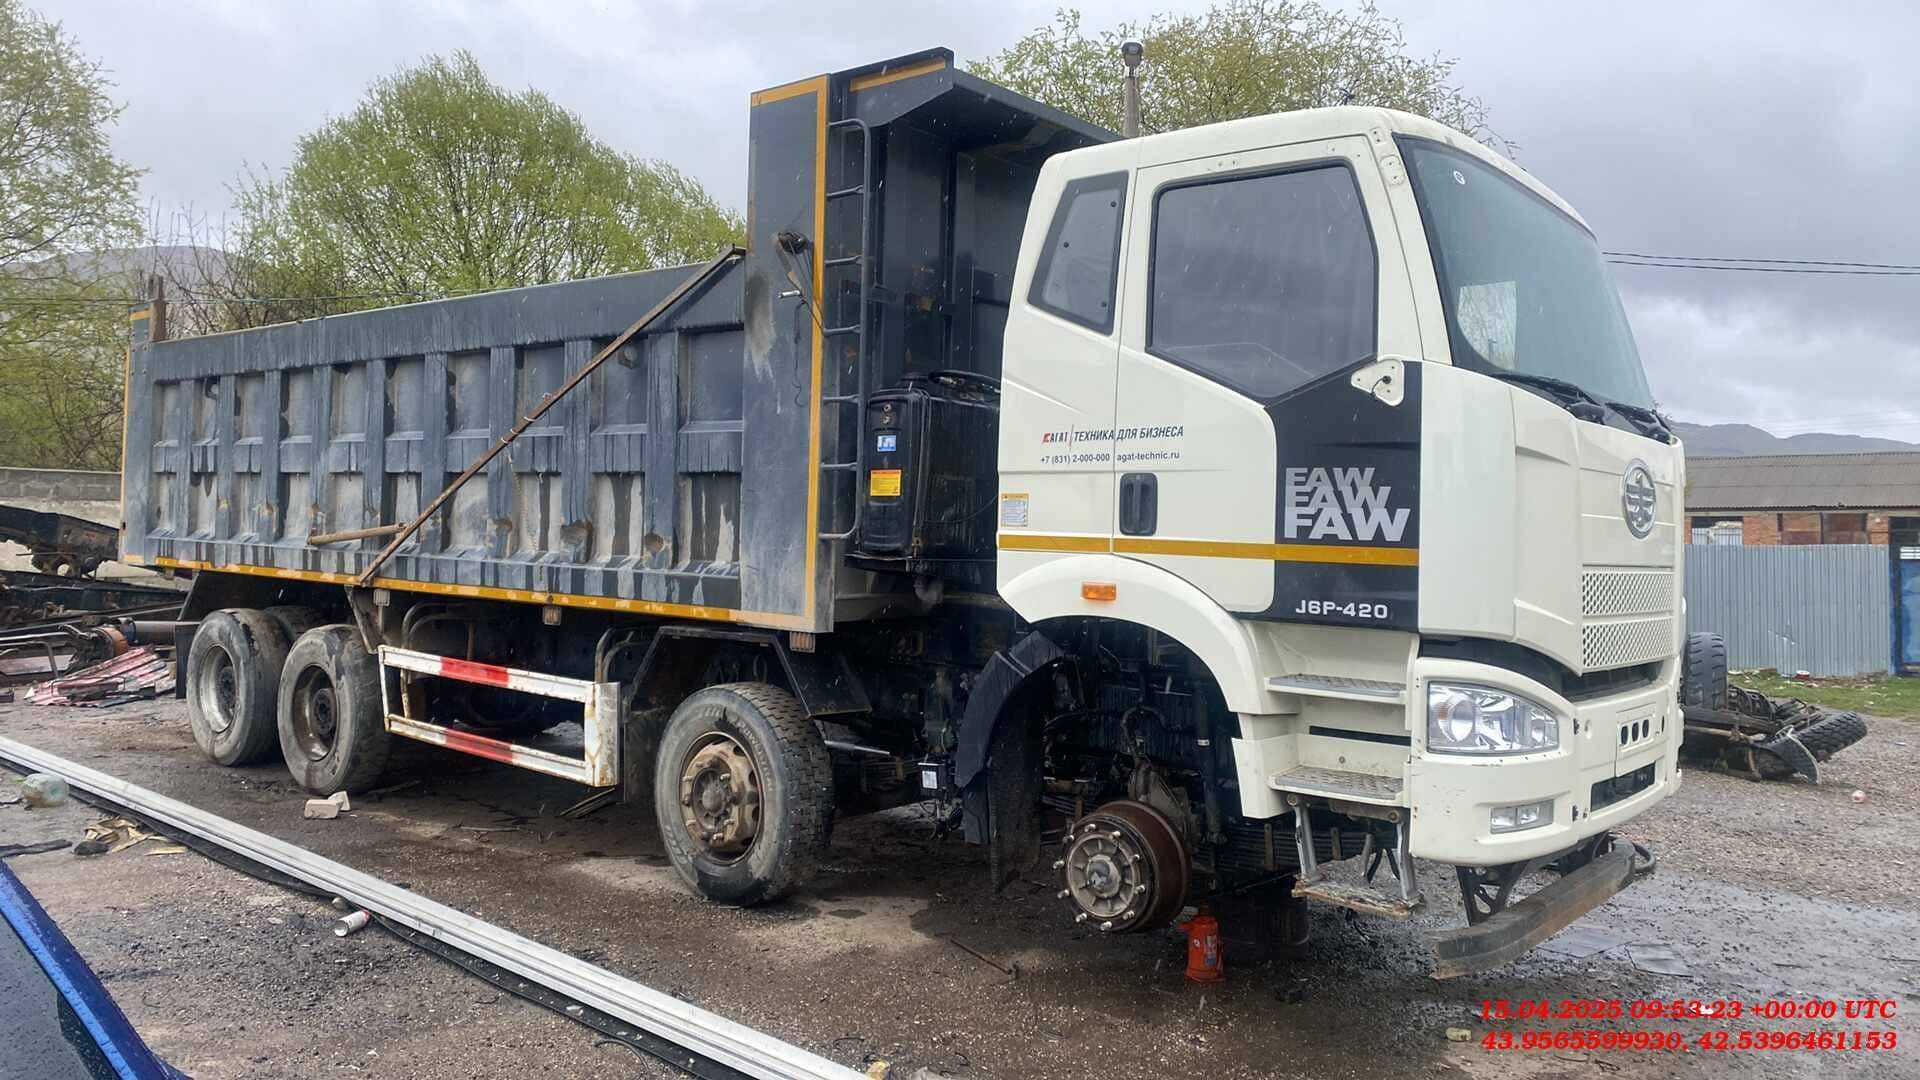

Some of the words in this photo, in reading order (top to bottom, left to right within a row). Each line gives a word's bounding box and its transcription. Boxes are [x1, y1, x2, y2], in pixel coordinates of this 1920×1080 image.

[1074, 430, 1115, 442] ТЕХНИКА
[1117, 428, 1138, 441] ДЛЯ
[1139, 425, 1184, 439] БИЗНЕСА
[1040, 455, 1050, 463] +7
[1051, 455, 1071, 465] (831)
[1072, 453, 1111, 463] 2-000-000
[1117, 450, 1181, 463] agat-technic.ru
[1284, 507, 1411, 542] FAW
[1295, 600, 1389, 619] J6P-420
